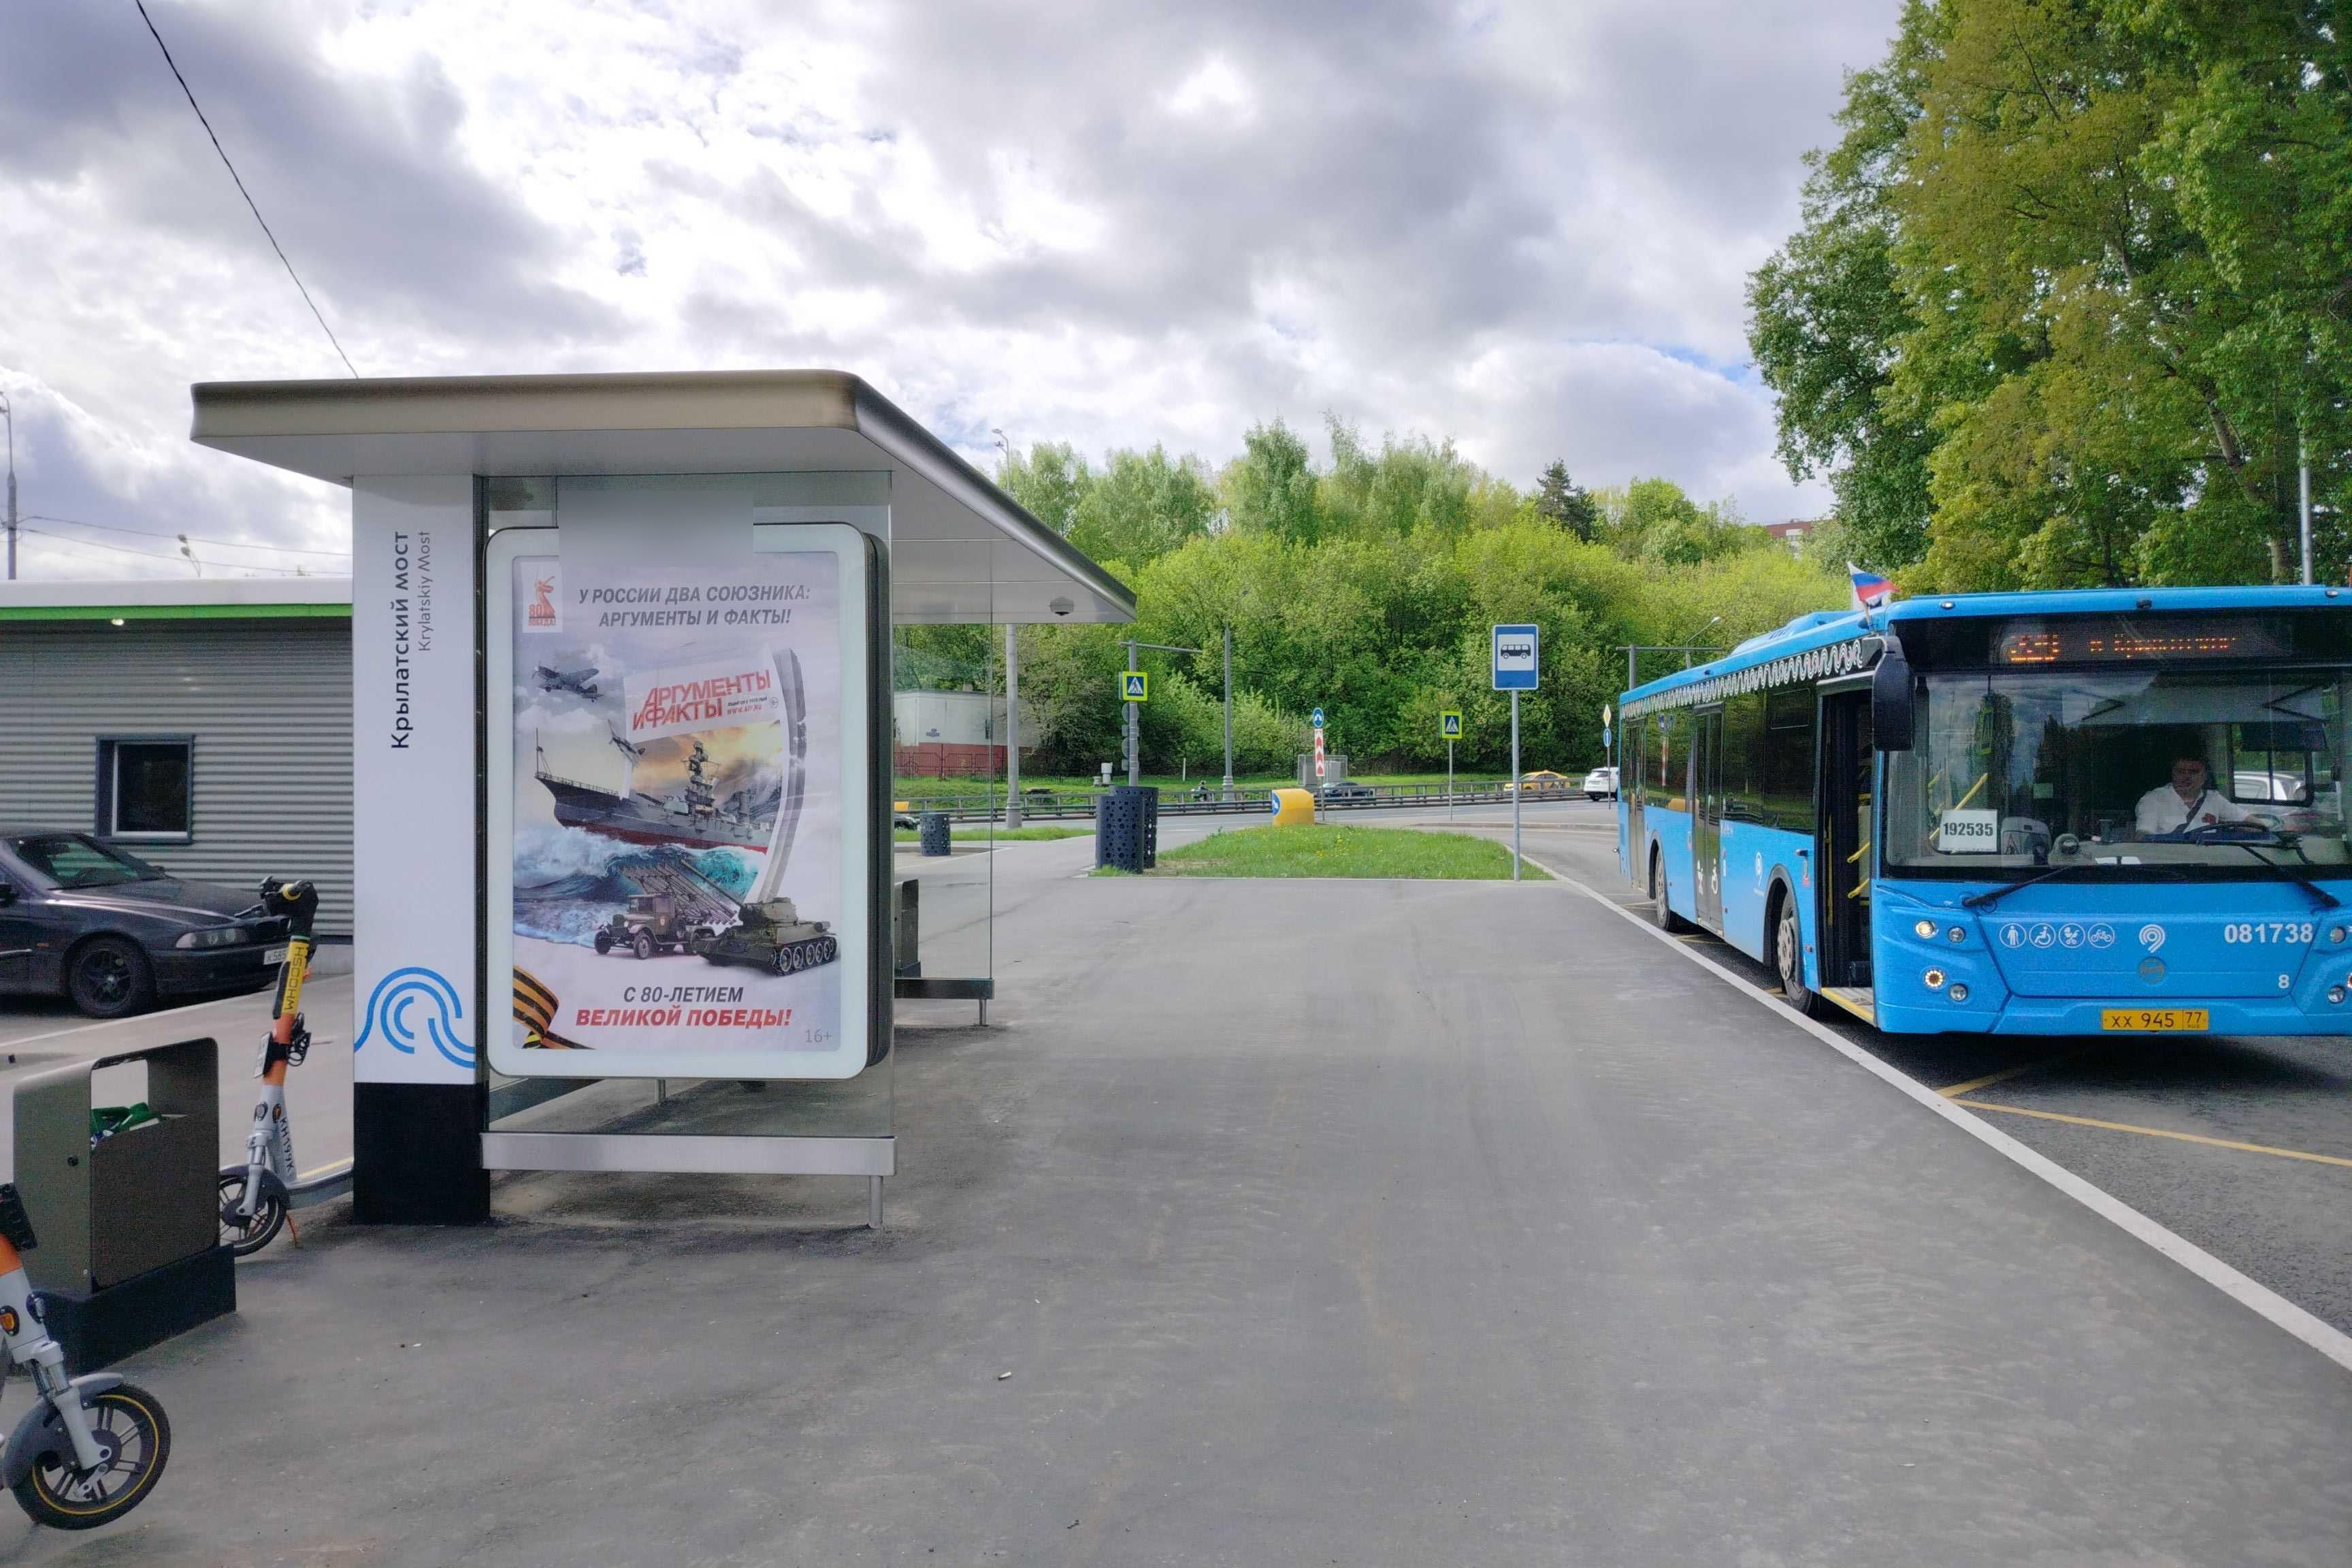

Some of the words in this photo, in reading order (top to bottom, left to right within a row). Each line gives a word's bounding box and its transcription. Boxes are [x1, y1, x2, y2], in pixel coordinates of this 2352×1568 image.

[394, 531, 409, 590] мост
[416, 530, 431, 572] Most
[578, 589, 589, 604] У
[591, 587, 662, 604] РОССИИ
[664, 587, 701, 605] ДВА
[706, 584, 811, 602] СОЮЗНИКА:
[418, 576, 434, 652] Krylatskiy
[529, 604, 543, 617] 80
[598, 610, 702, 627] АРГУМЕНТЫ
[706, 610, 719, 625] И
[723, 608, 791, 625] ФАКТЫ!
[390, 599, 414, 749] Крылатский
[644, 669, 772, 708] АРГУМЕНТЫ
[1943, 822, 1994, 836] 192535
[2223, 923, 2314, 944] 081738
[2278, 974, 2290, 989] 8
[623, 987, 636, 1003] С
[640, 986, 744, 1003] 80-ЛЕТИЕМ
[575, 1004, 683, 1027] ВЕЛИКОЙ
[685, 1009, 792, 1030] ПОБЕДЫ!
[2140, 1012, 2175, 1028] 945
[2185, 1011, 2202, 1024] 77
[804, 1028, 833, 1043] 16+
